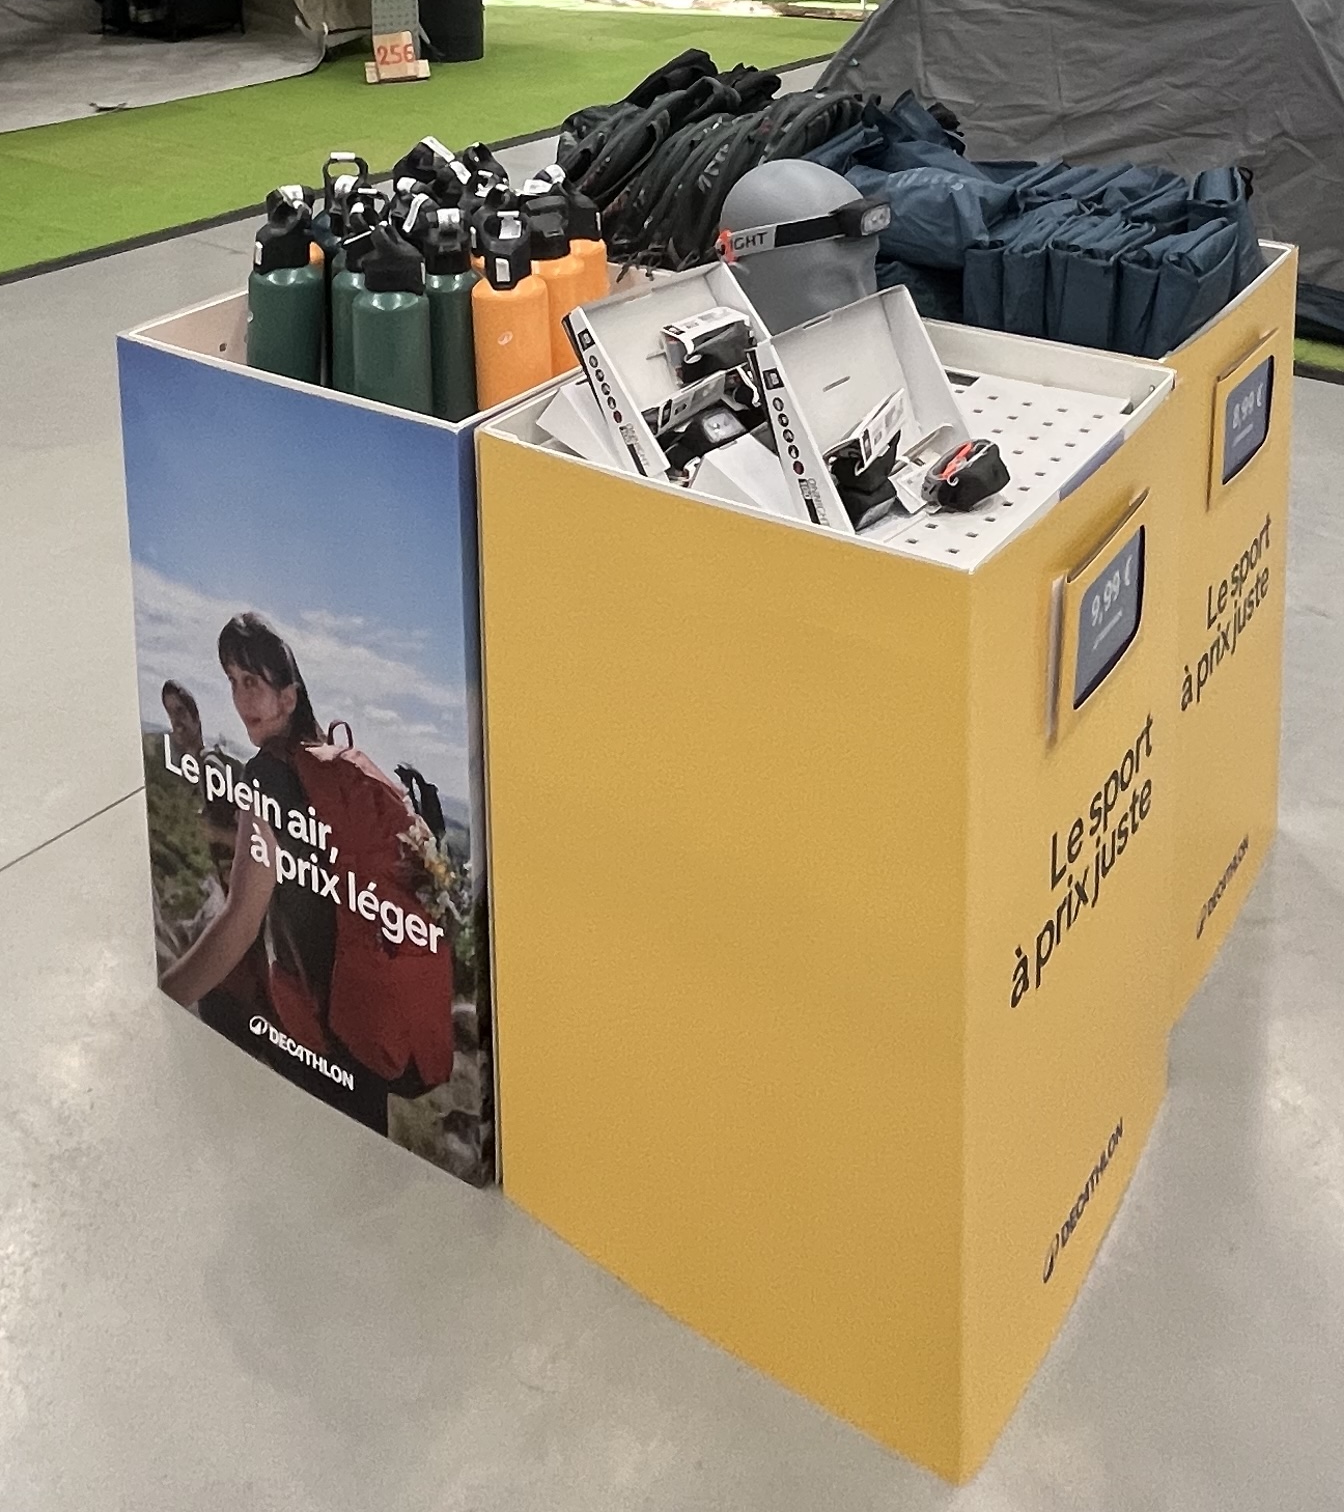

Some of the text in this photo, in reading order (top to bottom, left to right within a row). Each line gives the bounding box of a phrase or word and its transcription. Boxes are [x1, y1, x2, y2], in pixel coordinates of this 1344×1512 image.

[1206, 512, 1272, 630] Le sport
[1180, 566, 1270, 712] à prix juste
[163, 733, 339, 864] Le plein air,
[1050, 711, 1153, 891] Le sport
[250, 822, 445, 954] à prix léger
[1010, 778, 1153, 1009] à prix juste
[268, 1023, 355, 1091] DECATHLON
[1060, 1116, 1124, 1249] DECATHLON
